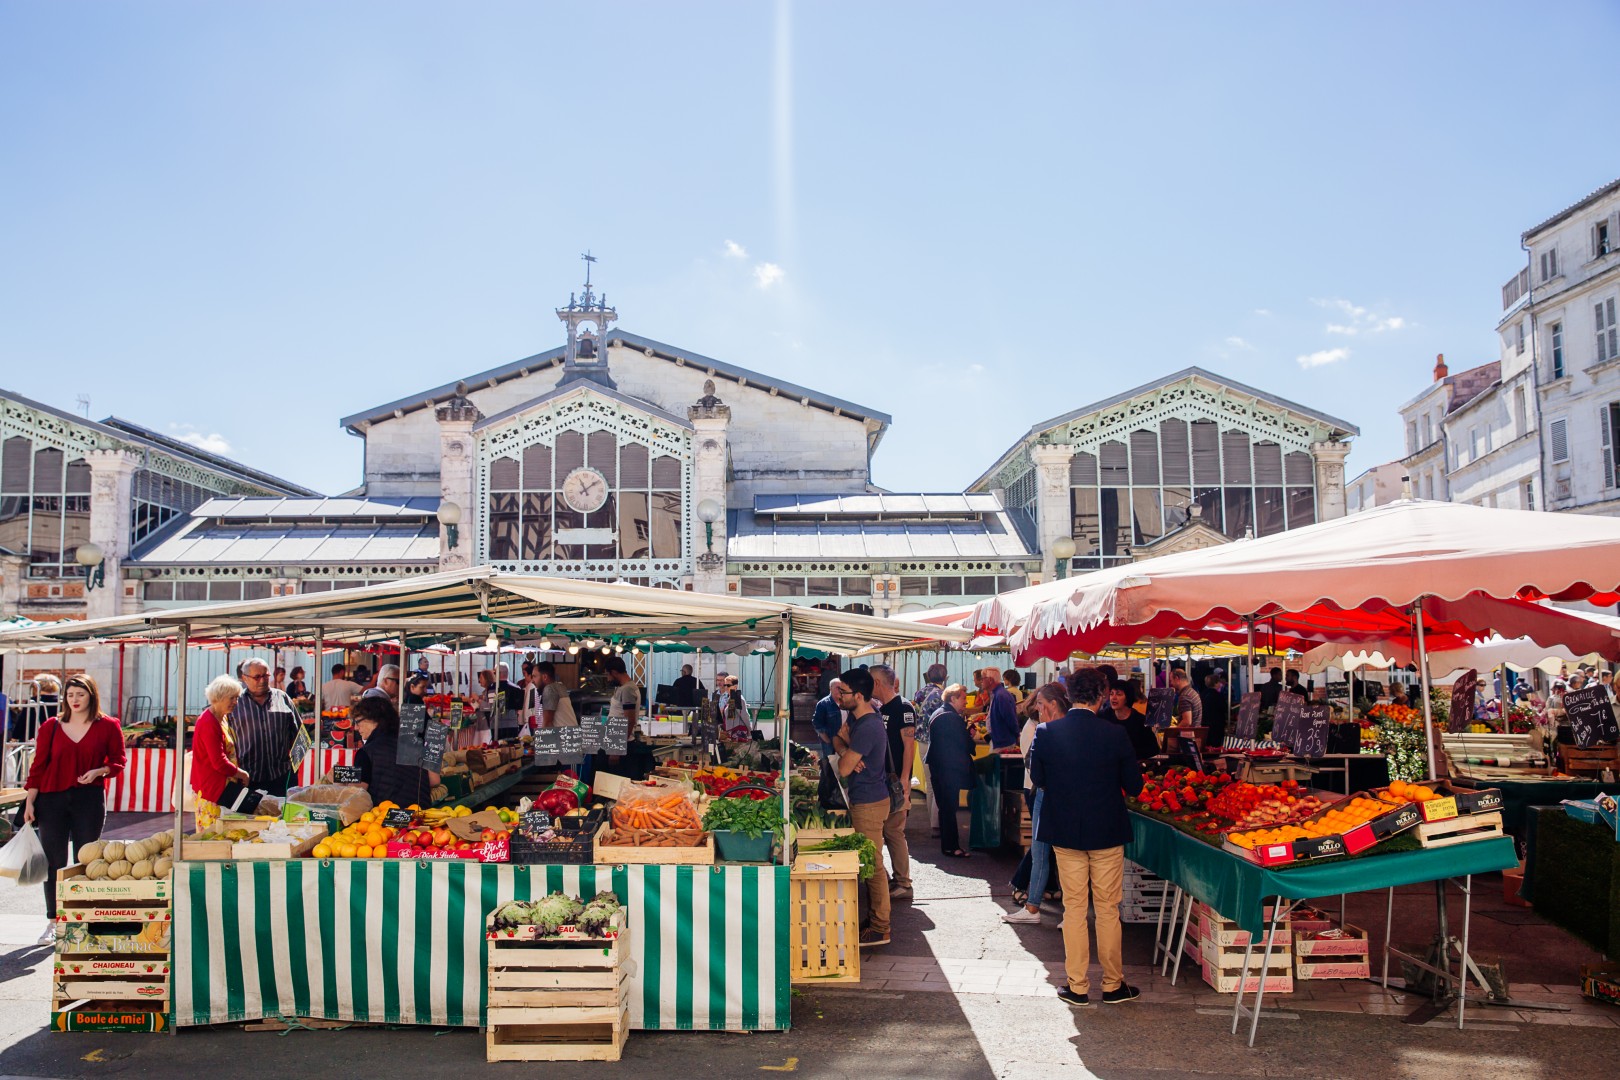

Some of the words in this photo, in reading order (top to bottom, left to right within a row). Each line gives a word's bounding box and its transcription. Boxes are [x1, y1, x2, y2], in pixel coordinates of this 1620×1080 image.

[1564, 690, 1596, 706] GRENAILLE
[1477, 797, 1501, 806] BOLLO
[1395, 812, 1417, 826] BOLLO
[1318, 842, 1341, 851] BOLLO
[438, 850, 460, 859] Lady
[483, 849, 508, 863] Lady
[76, 938, 93, 952] Le
[76, 1013, 107, 1025] Boule
[107, 1014, 119, 1024] de
